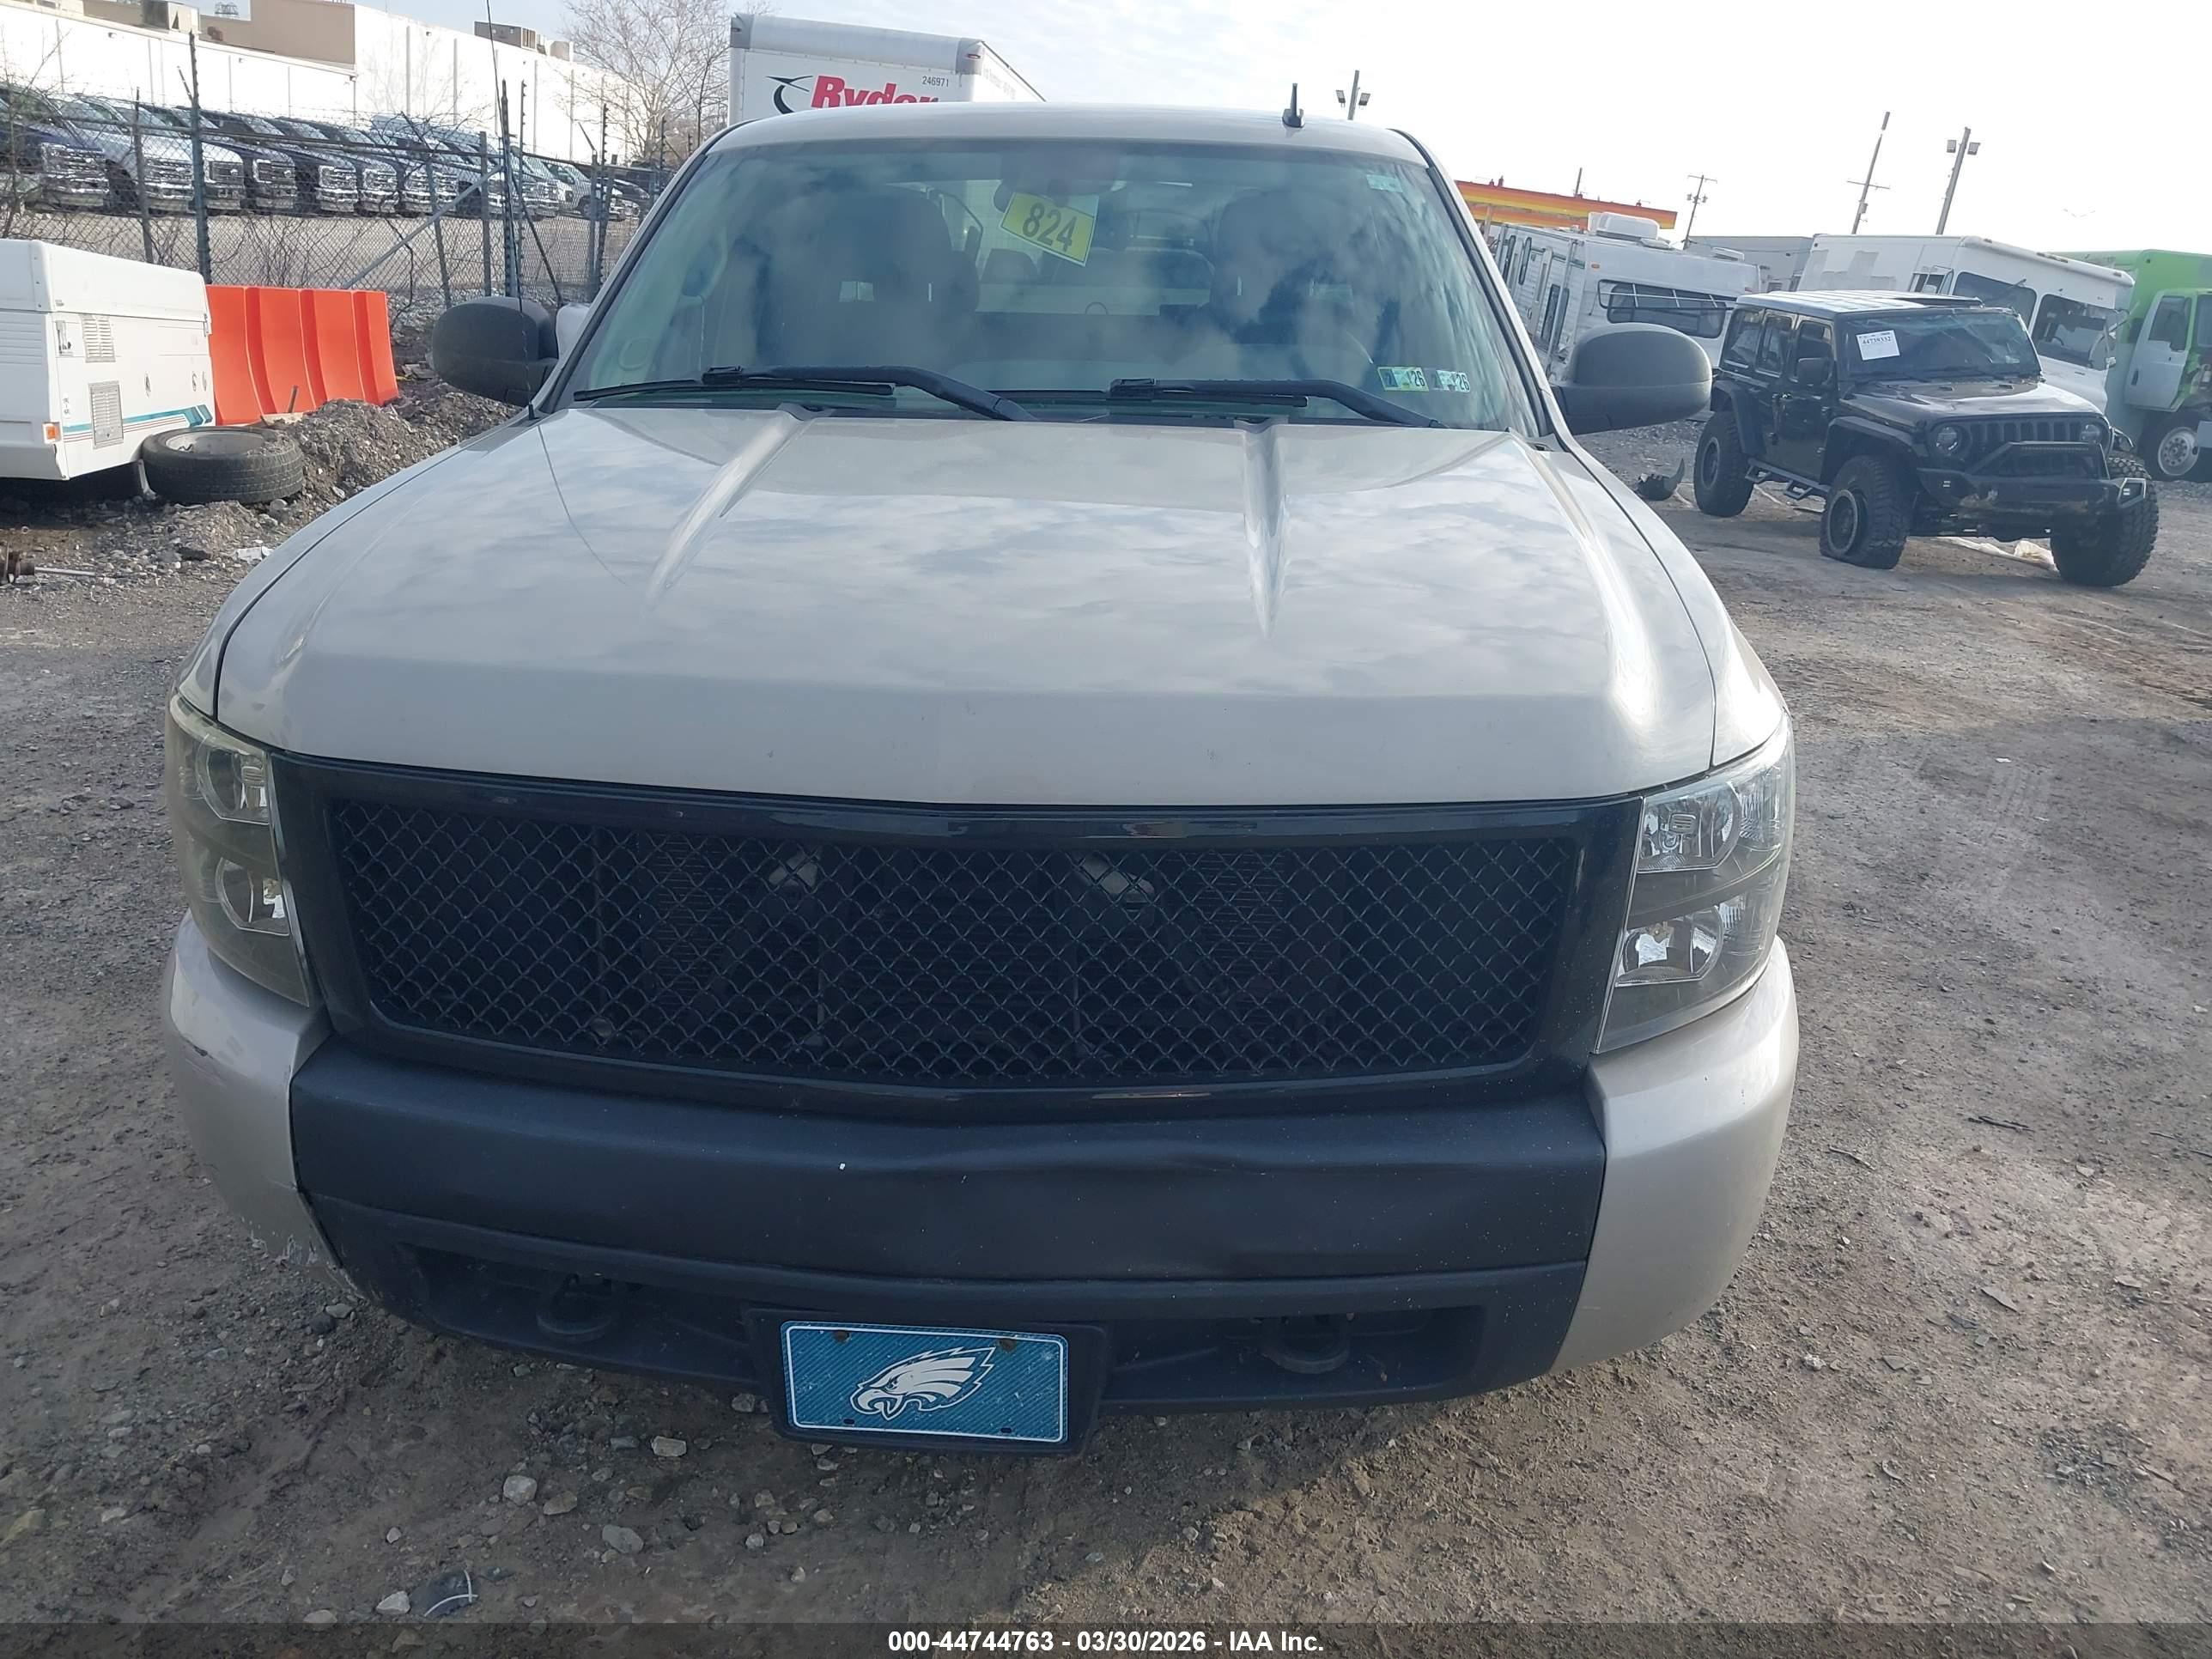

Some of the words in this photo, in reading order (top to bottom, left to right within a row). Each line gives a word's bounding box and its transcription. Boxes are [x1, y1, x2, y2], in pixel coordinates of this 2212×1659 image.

[921, 75, 949, 88] 246971
[811, 75, 939, 108] Ryd
[1022, 203, 1078, 252] 824
[1412, 370, 1425, 387] 26
[1456, 374, 1470, 391] 26
